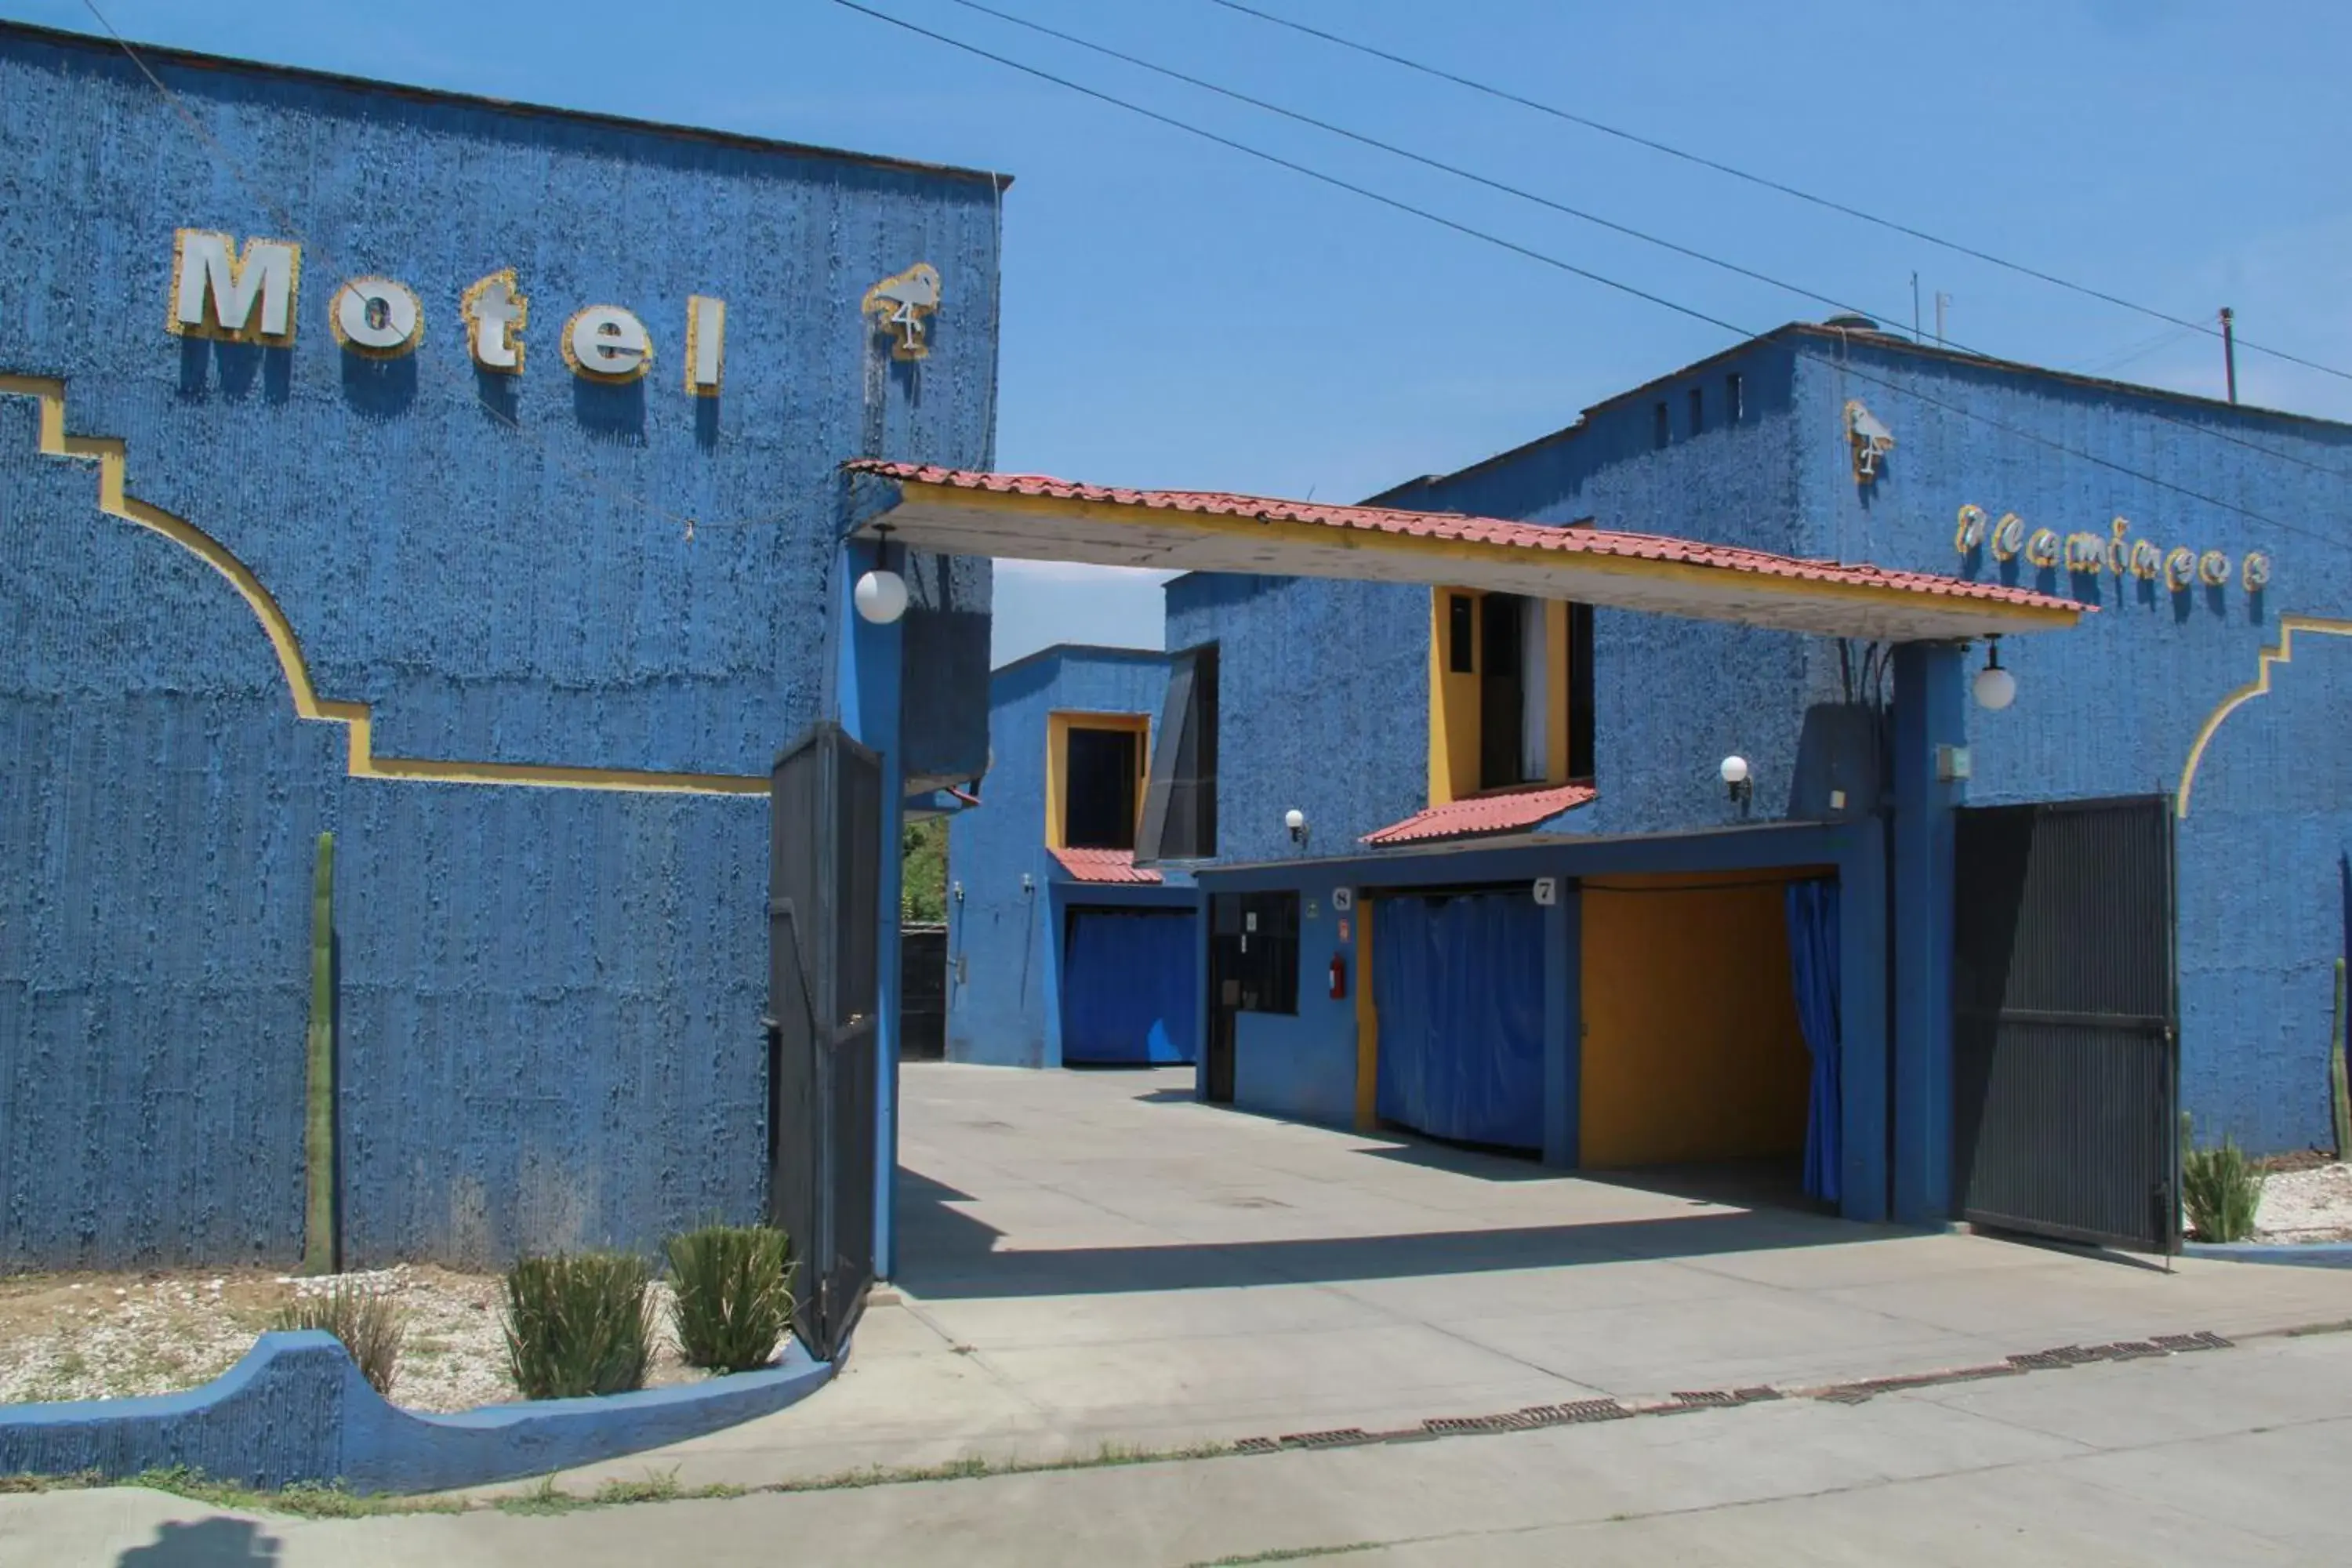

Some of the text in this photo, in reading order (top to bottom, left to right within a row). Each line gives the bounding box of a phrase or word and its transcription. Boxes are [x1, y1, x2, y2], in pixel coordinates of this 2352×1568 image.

[168, 228, 724, 395] Motel
[1336, 890, 1348, 906] 8
[1537, 881, 1552, 901] 7
